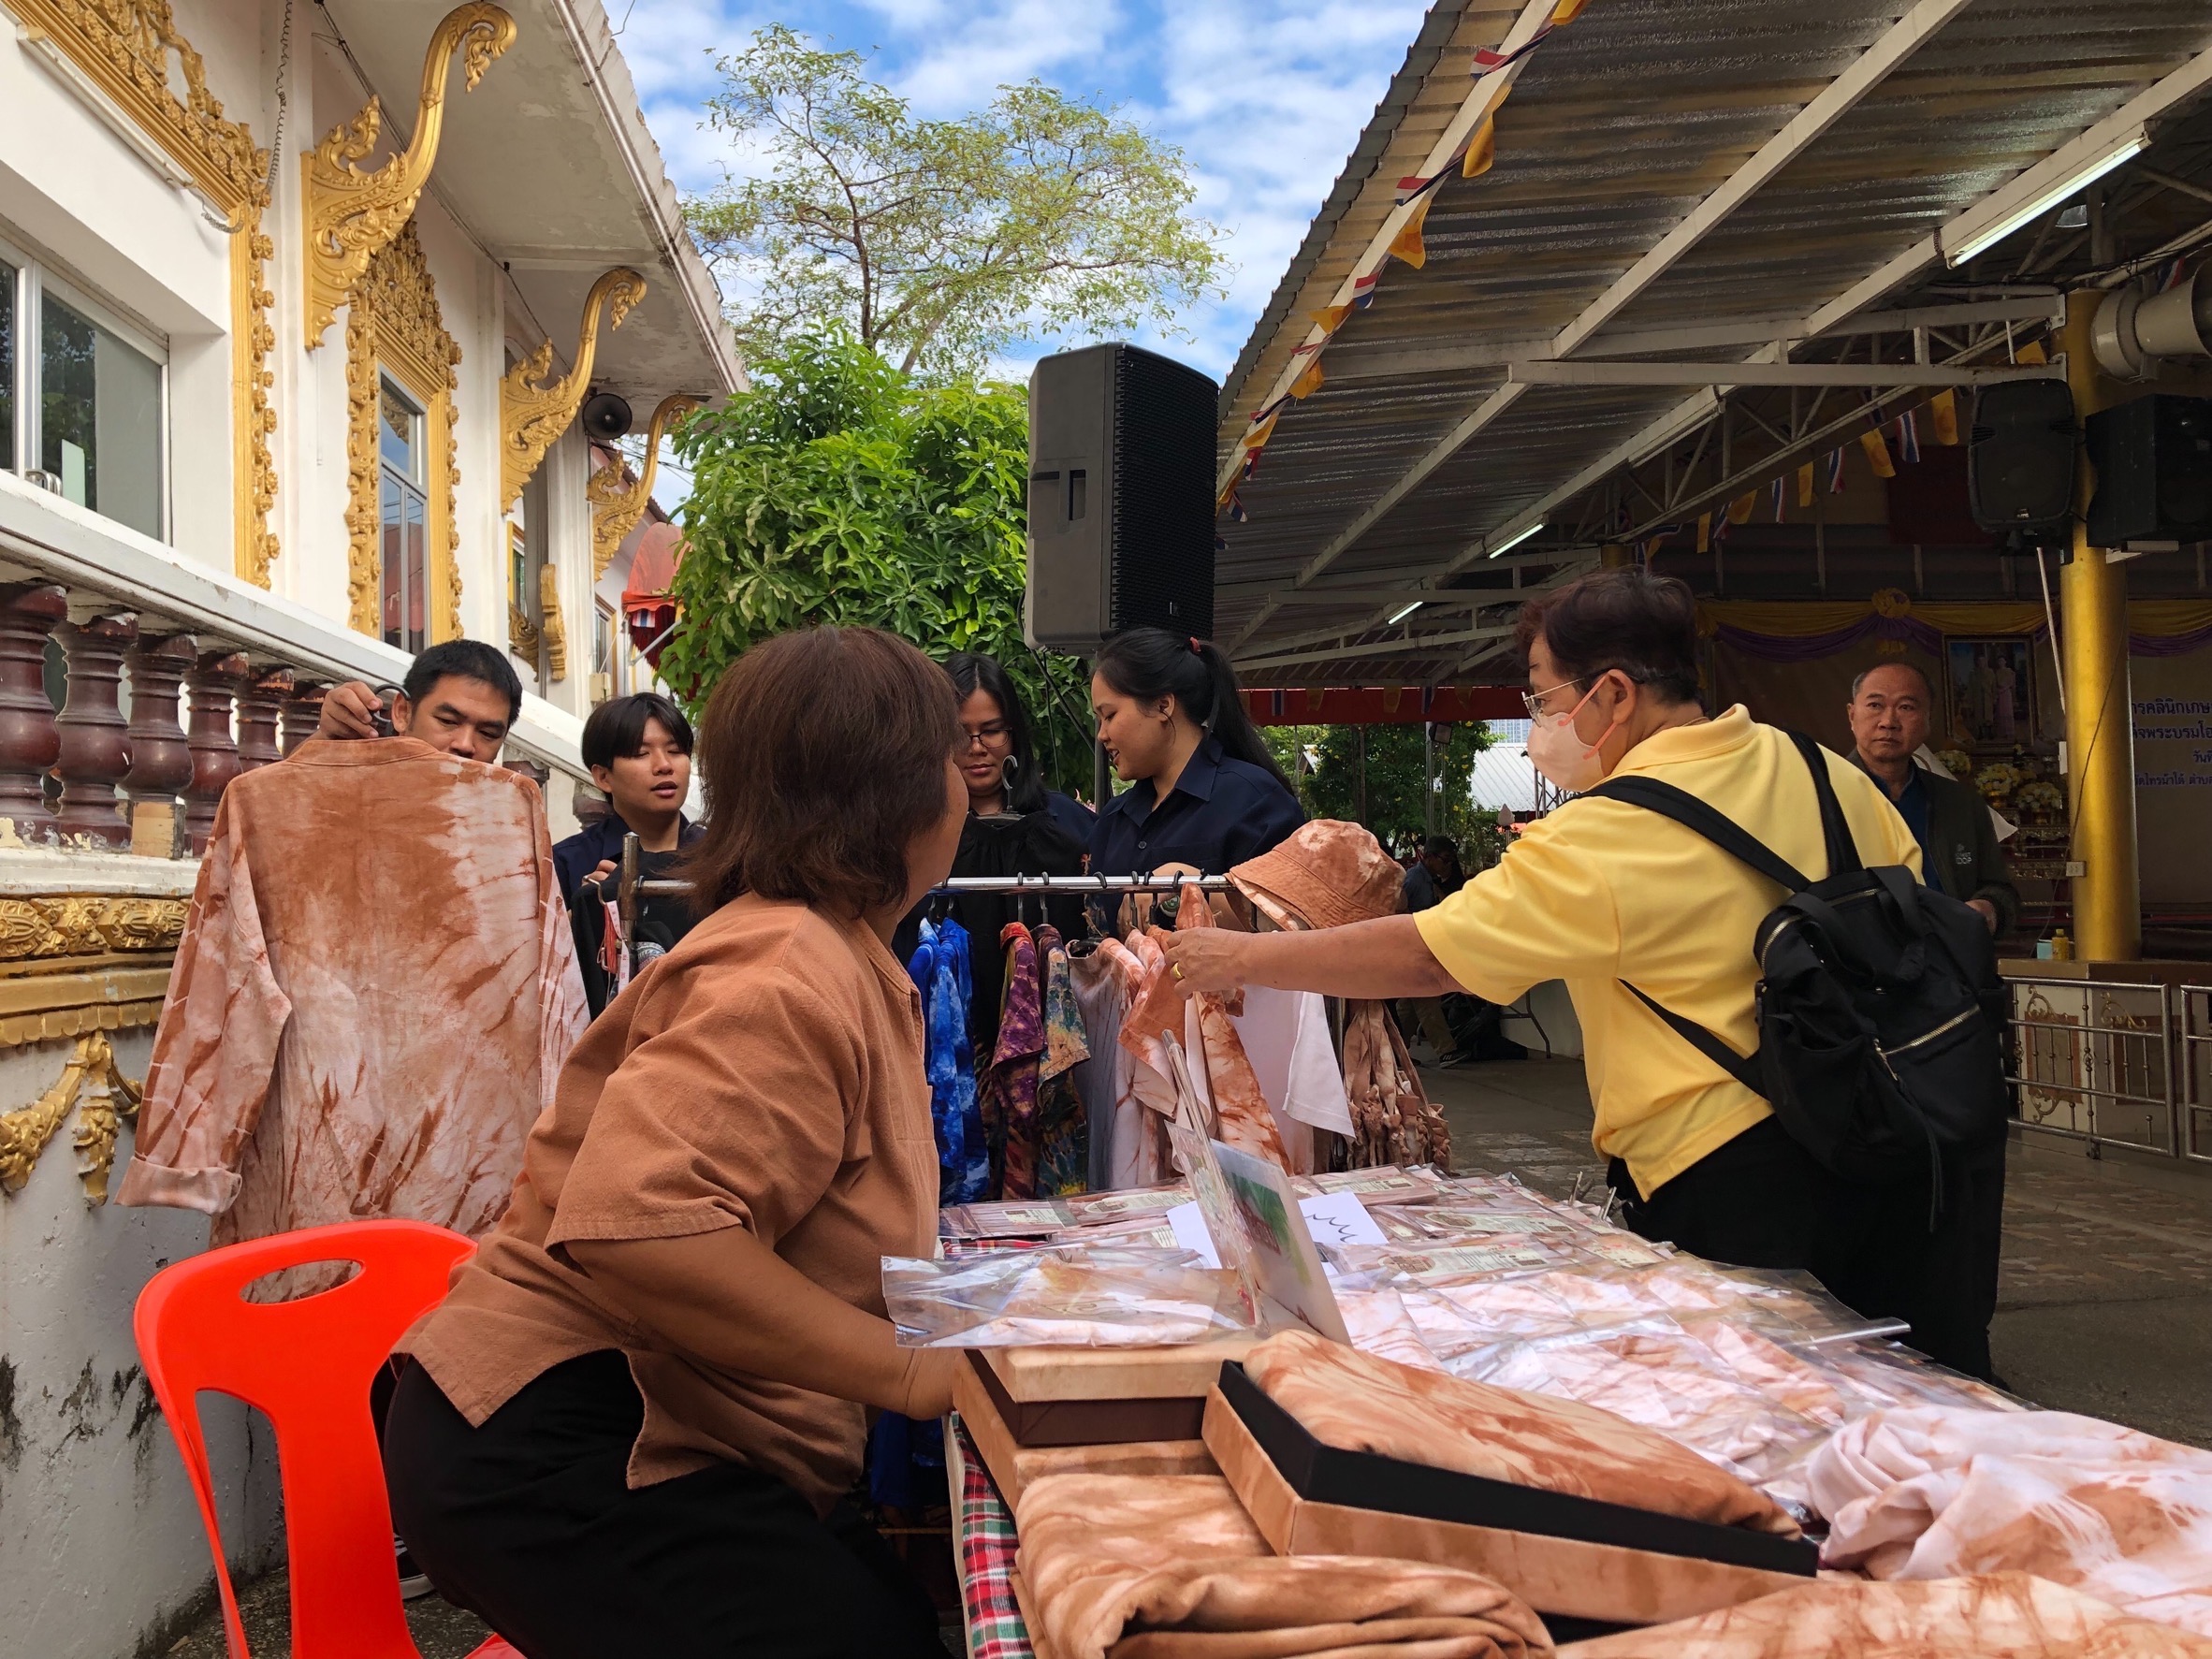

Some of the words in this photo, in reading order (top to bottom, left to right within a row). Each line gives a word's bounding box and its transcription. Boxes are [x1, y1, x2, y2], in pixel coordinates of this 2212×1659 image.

[2132, 697, 2212, 715] ารคลินิกเกษ
